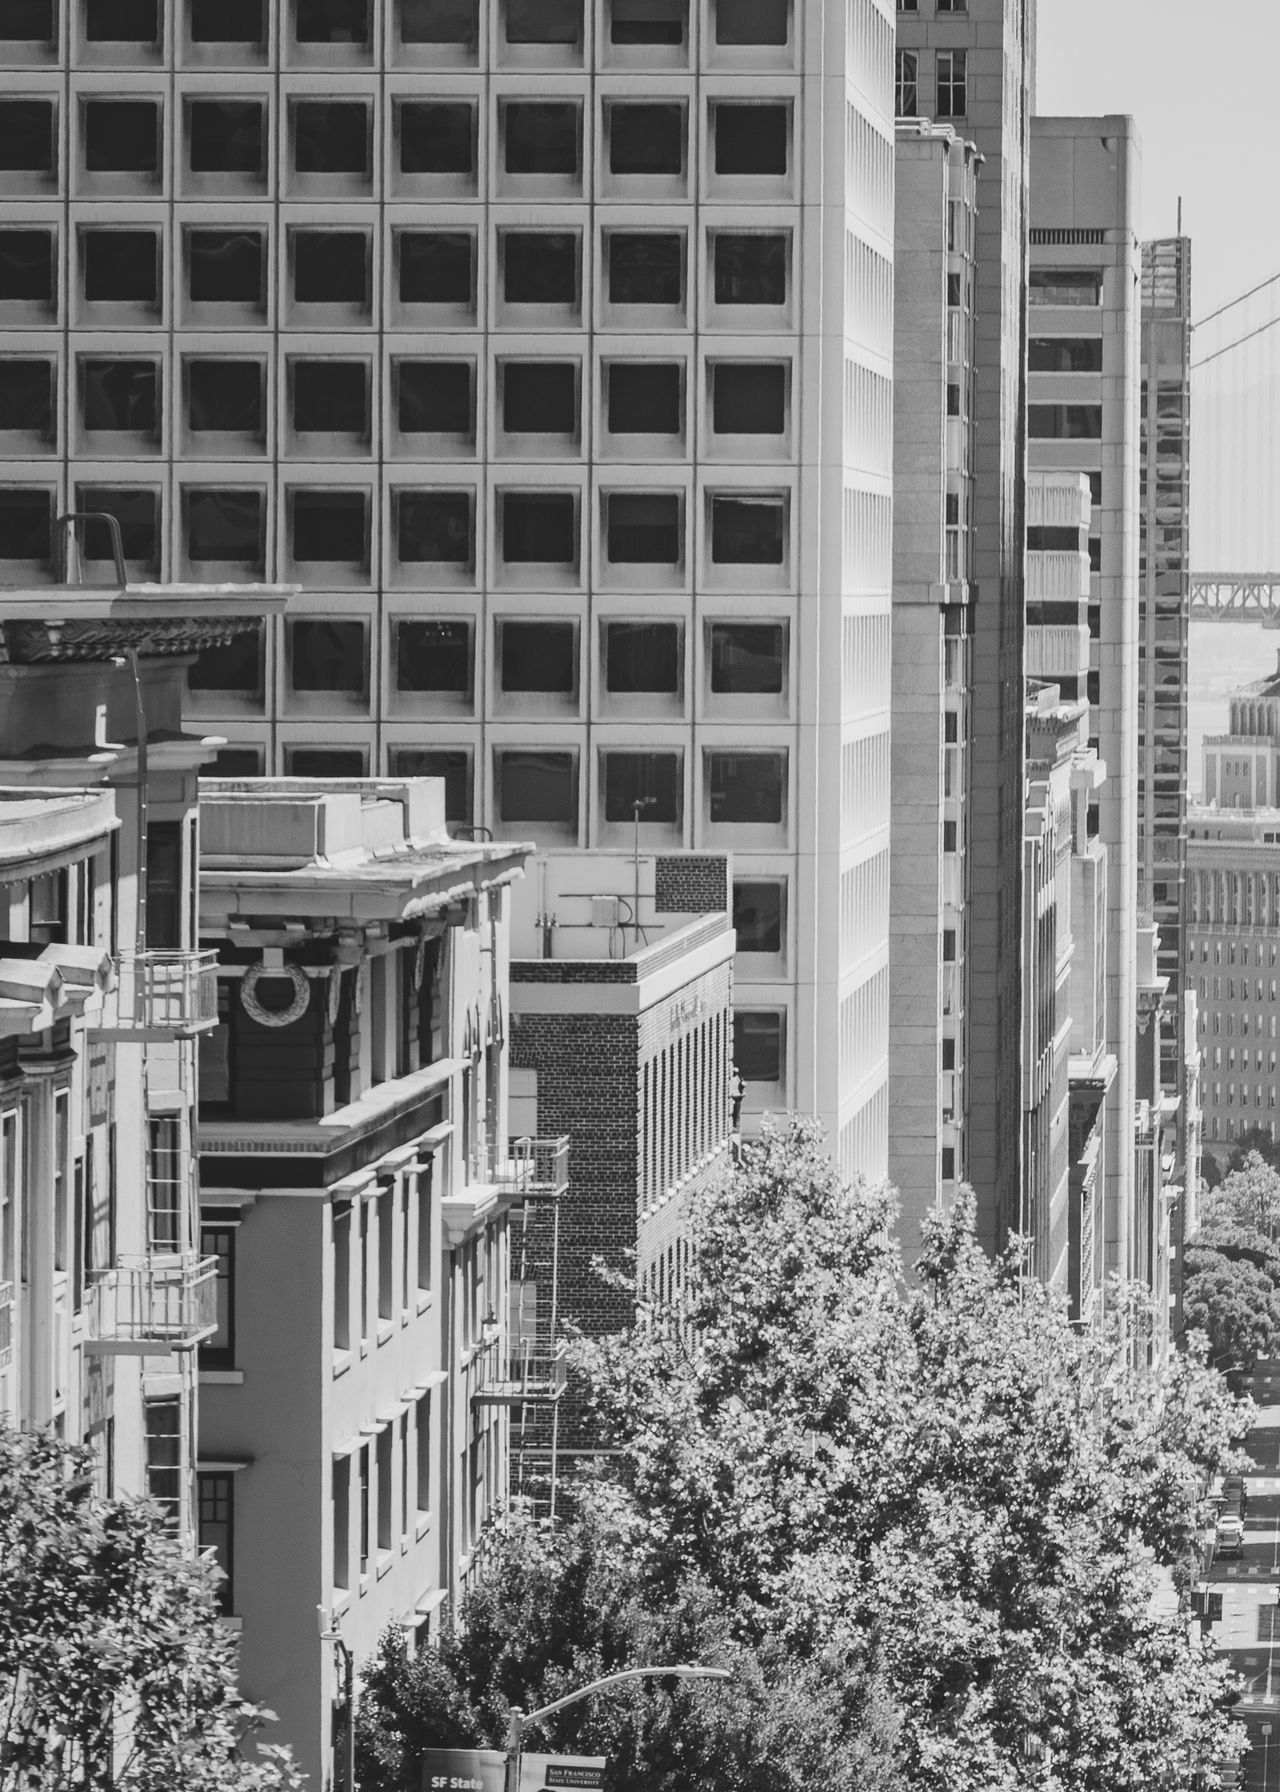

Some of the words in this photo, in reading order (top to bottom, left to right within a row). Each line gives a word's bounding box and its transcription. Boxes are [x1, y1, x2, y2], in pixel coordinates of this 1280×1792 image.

[549, 1768, 562, 1777] SAN
[564, 1769, 601, 1778] FRANCISCO
[431, 1776, 448, 1788] SF
[450, 1777, 483, 1790] State
[566, 1777, 600, 1786] UNIVERSITY
